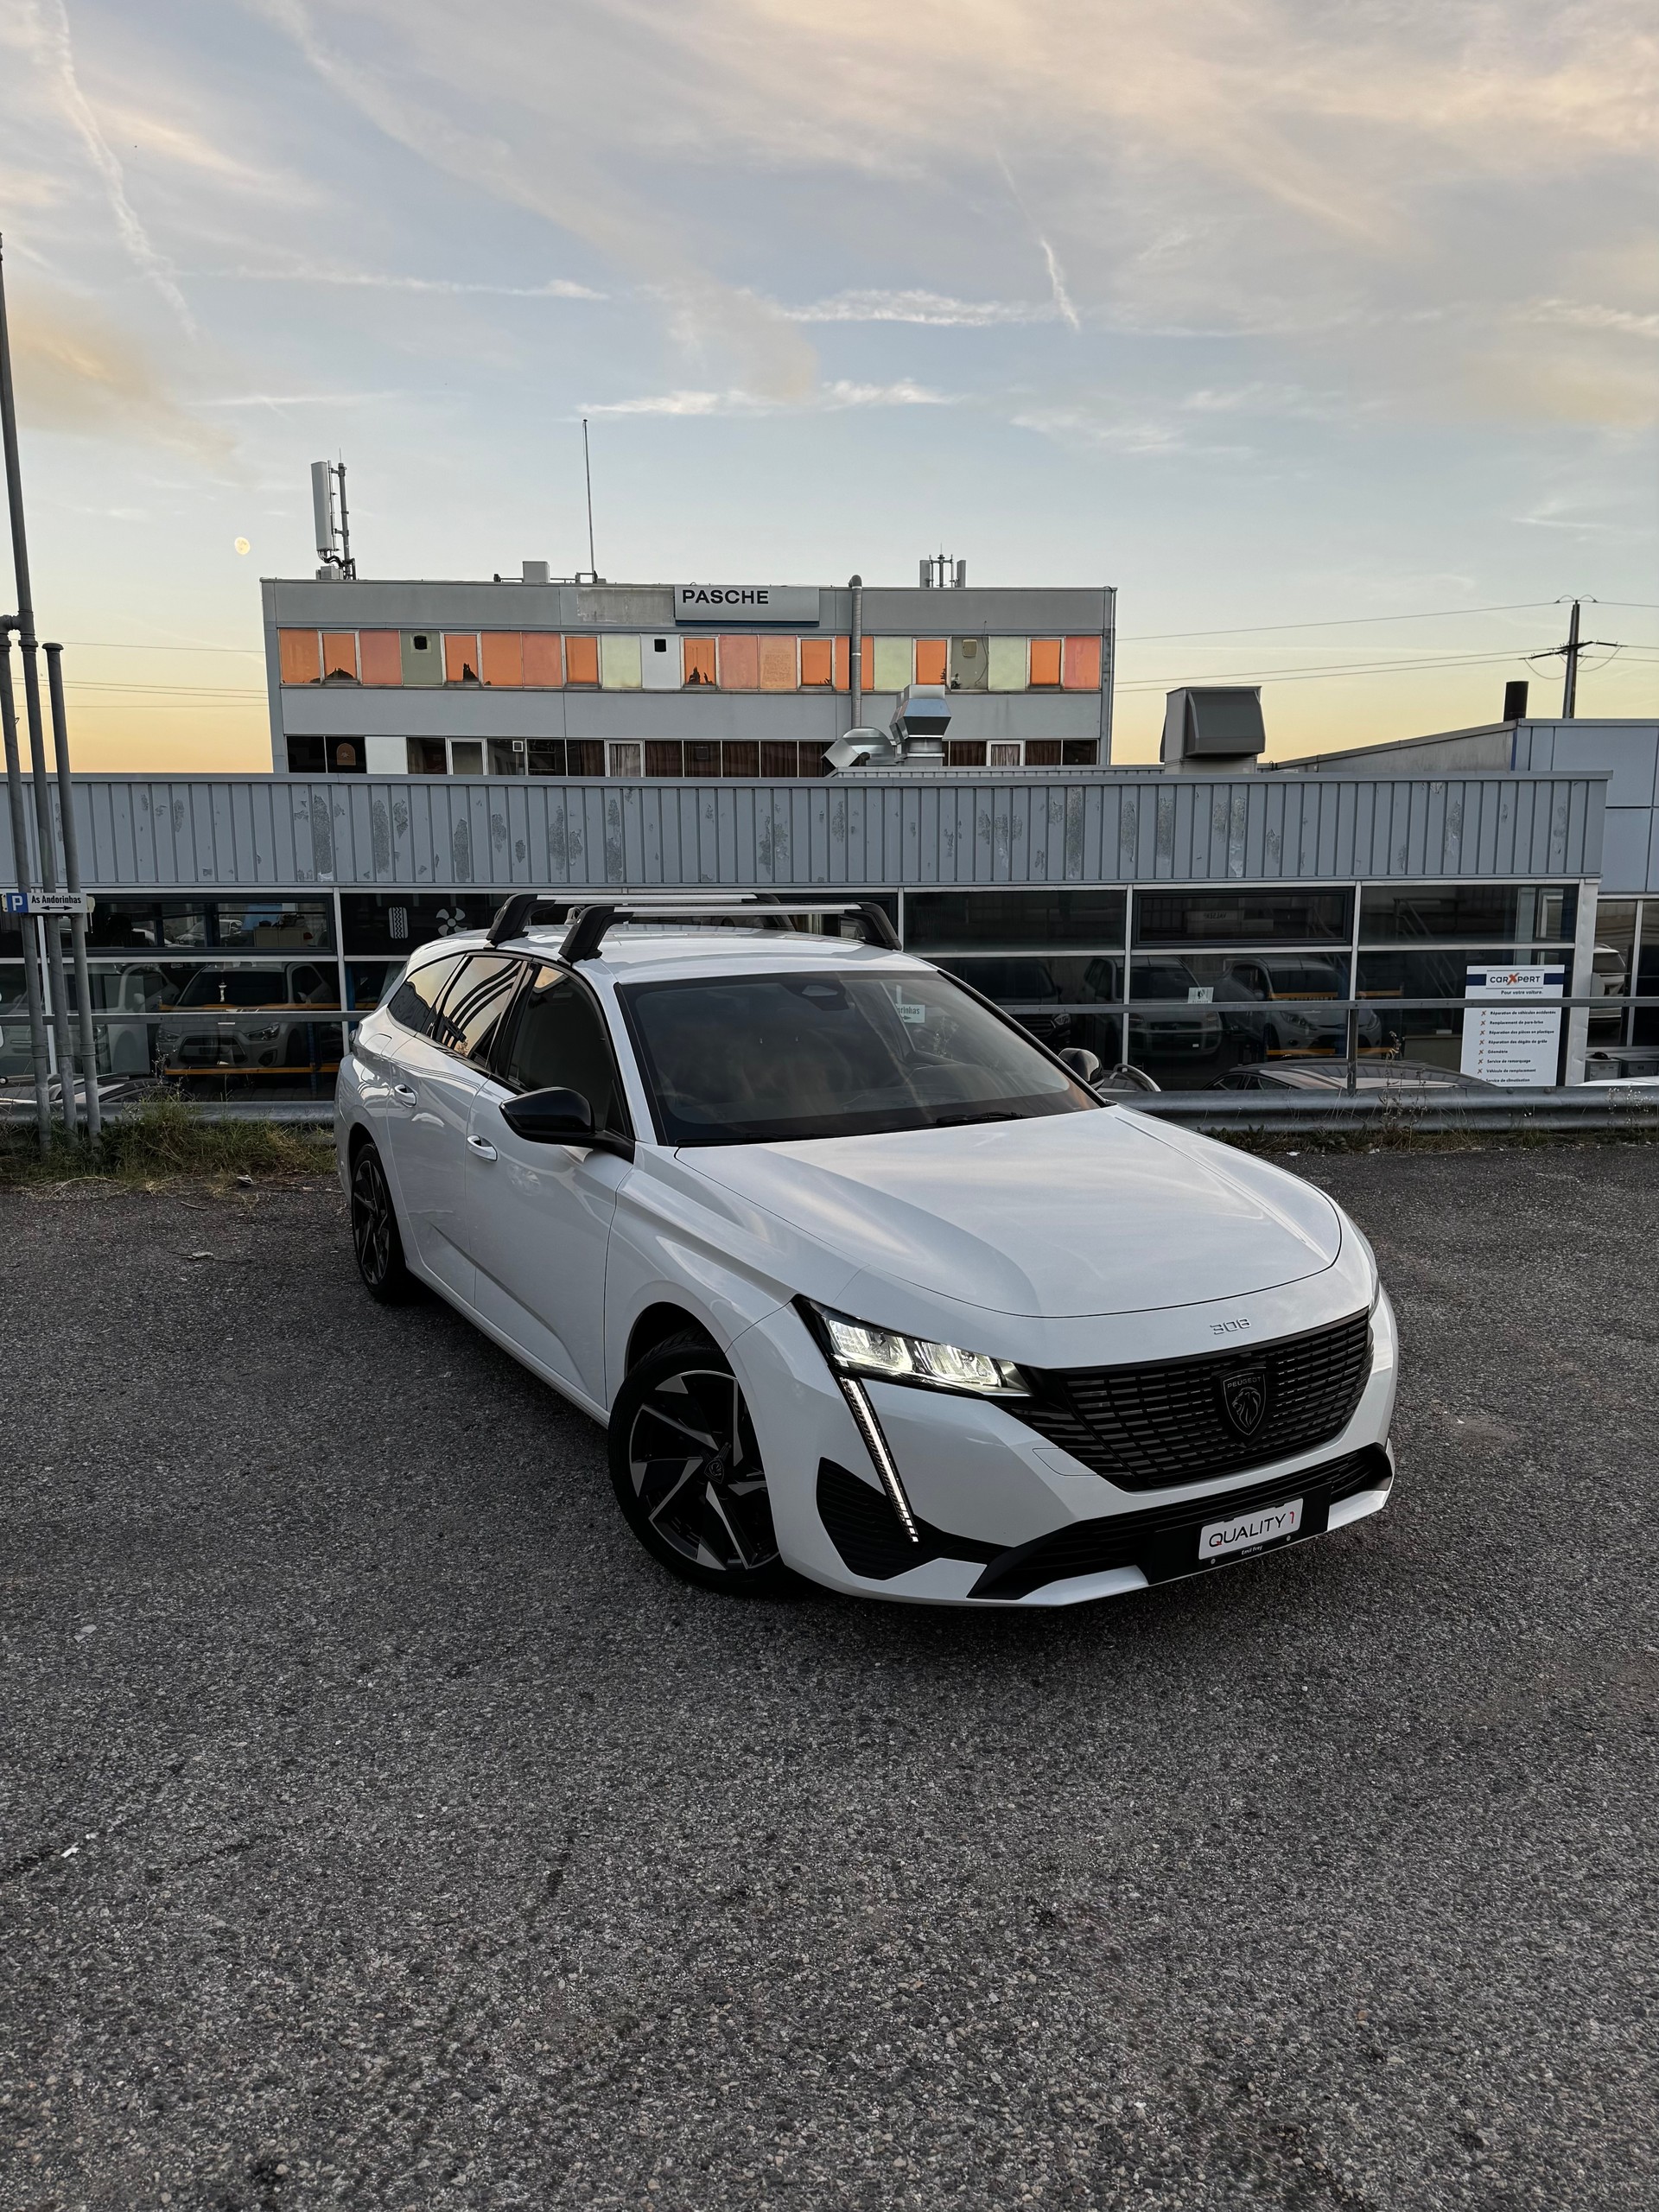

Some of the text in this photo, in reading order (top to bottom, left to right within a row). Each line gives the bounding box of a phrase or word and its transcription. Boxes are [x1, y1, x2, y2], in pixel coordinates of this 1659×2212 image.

[683, 589, 769, 604] PASCHE
[11, 895, 81, 911] P As Andorinhas
[1210, 1318, 1251, 1335] 308
[1227, 1376, 1262, 1389] PEUGEOT
[1209, 1511, 1295, 1548] QUALITY 1
